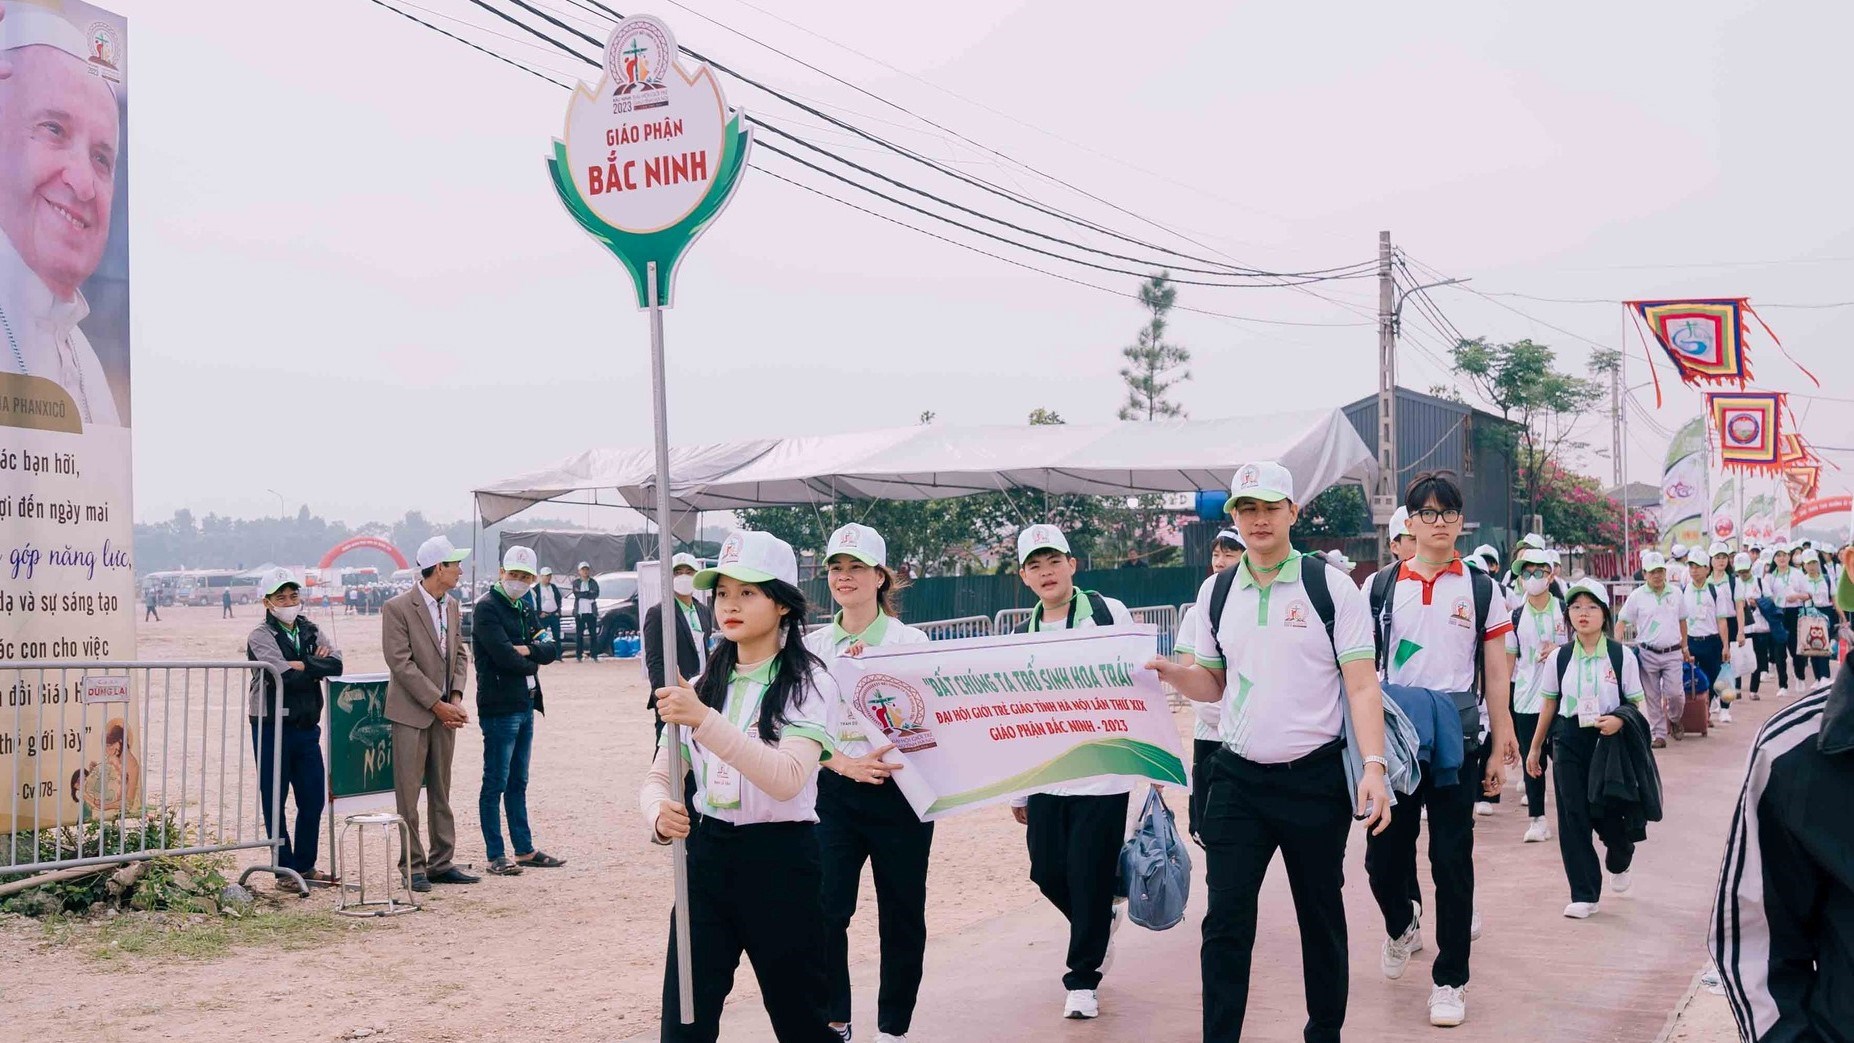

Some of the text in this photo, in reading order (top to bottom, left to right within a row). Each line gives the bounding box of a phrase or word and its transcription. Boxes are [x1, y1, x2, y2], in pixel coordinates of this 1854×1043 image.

[612, 101, 632, 114] 2023
[606, 117, 684, 147] GIÁO PHẬN
[588, 150, 708, 196] BẮC NINH
[0, 396, 66, 418] A PHANXICÔ
[23, 449, 49, 476] bạn
[55, 452, 80, 478] hỡi,
[18, 494, 44, 519] đến
[50, 500, 81, 524] ngày
[86, 502, 109, 522] mai
[10, 538, 132, 580] góp năng lực,
[20, 591, 35, 612] và
[41, 593, 58, 616] sự
[62, 591, 94, 615] sáng
[98, 592, 118, 616] tạo
[21, 641, 46, 659] con
[53, 636, 77, 658] cho
[82, 636, 109, 660] việc
[953, 668, 1000, 695] CHÚNG
[993, 672, 1019, 693] TA
[1012, 654, 1043, 692] TRỔ
[1039, 667, 1074, 690] SINH
[1069, 665, 1103, 688] HOA
[935, 710, 953, 725] ĐẠI
[952, 706, 972, 723] HỘI
[971, 704, 993, 719] GIỚI
[1010, 701, 1034, 715] GIÁO
[1057, 699, 1073, 712] HÀ
[1072, 698, 1092, 713] NỘI
[1090, 696, 1110, 711] LẦN
[1129, 699, 1148, 711] XIX
[989, 723, 1017, 741] GIÁO
[1016, 720, 1047, 739] PHẬN
[1045, 716, 1068, 735] BẮC
[1067, 720, 1095, 733] NINH
[1101, 719, 1128, 732] 2023
